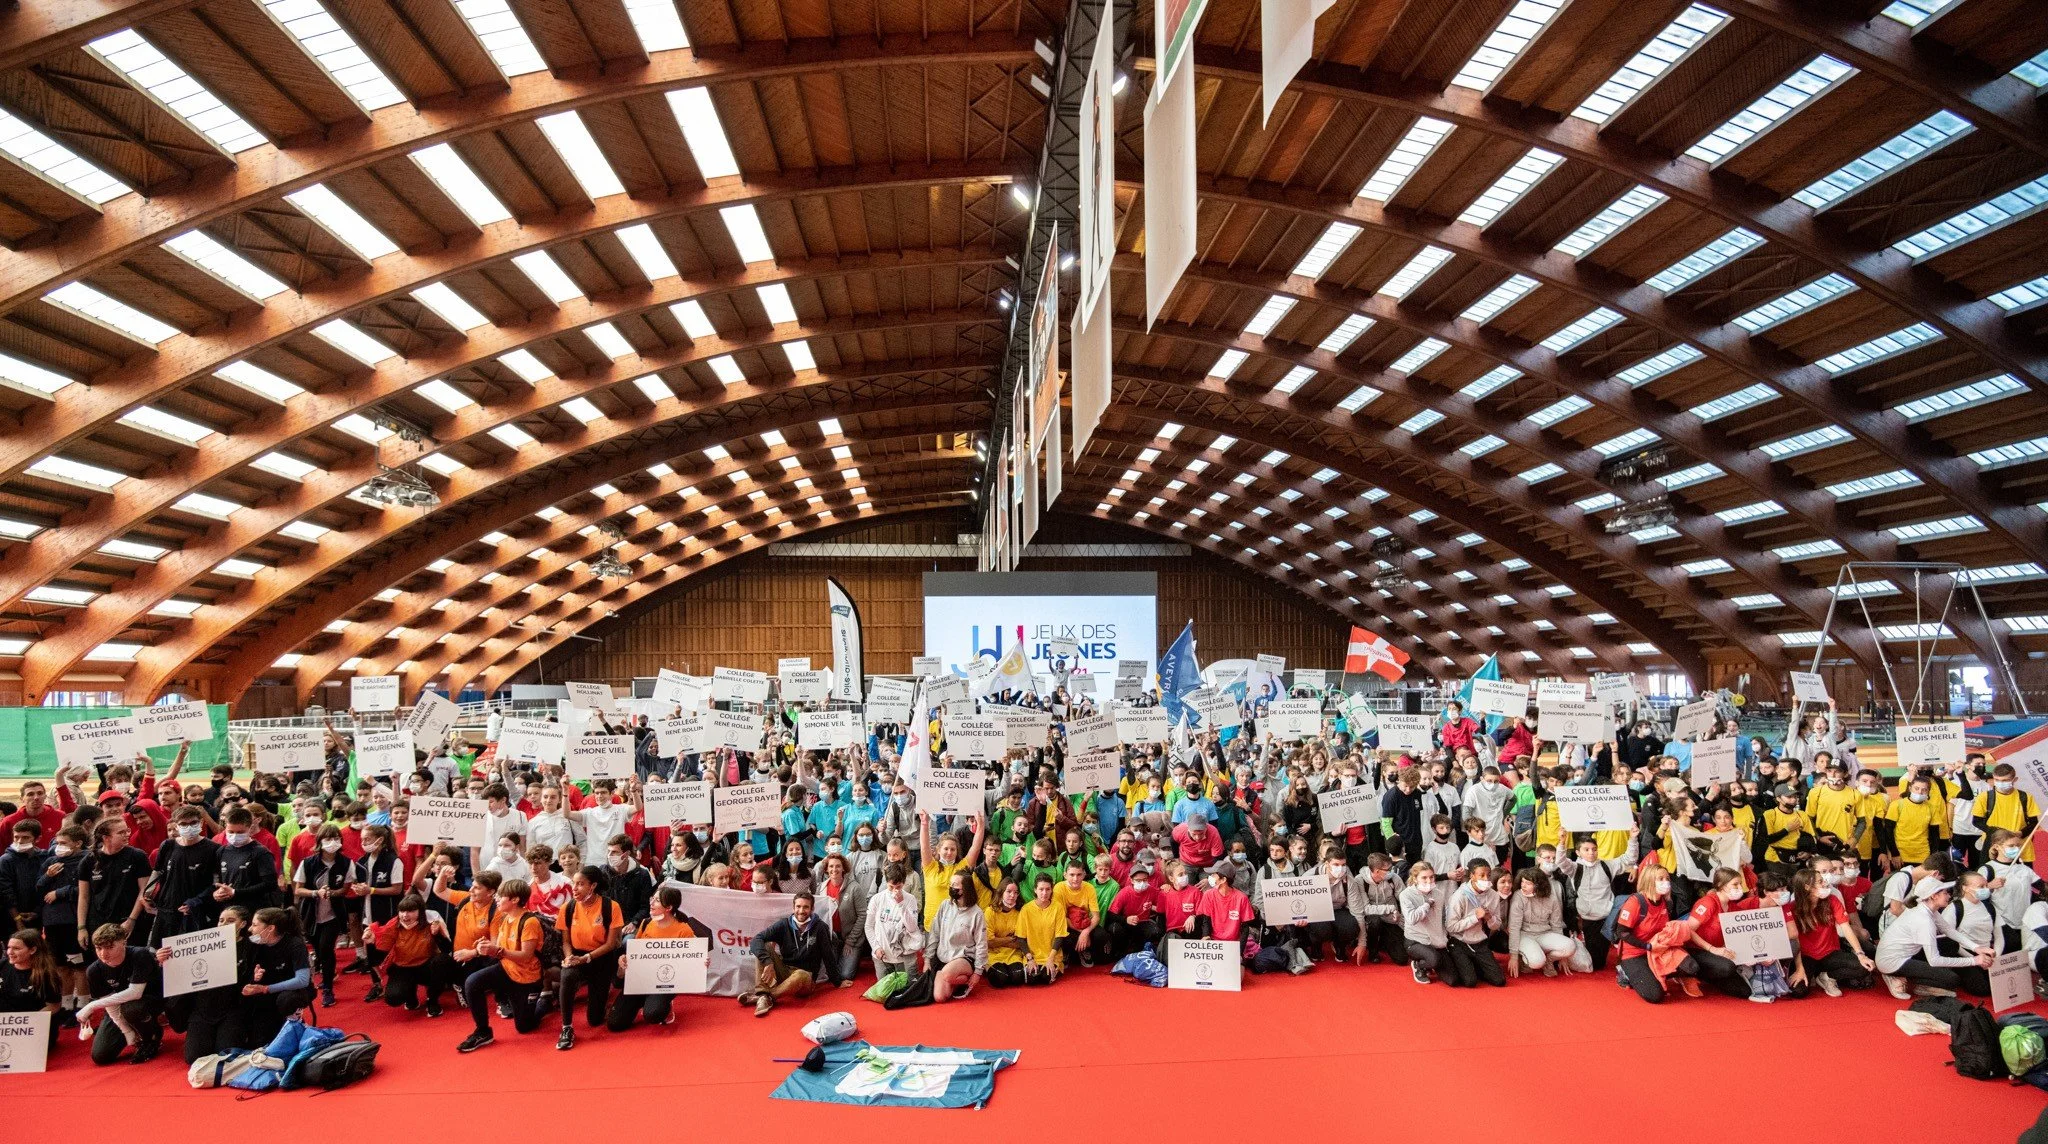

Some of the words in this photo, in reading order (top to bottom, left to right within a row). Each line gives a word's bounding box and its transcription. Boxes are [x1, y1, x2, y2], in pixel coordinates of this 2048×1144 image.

[1031, 624, 1076, 639] JEUX
[1082, 624, 1117, 639] DES
[1031, 642, 1117, 660] JENES
[726, 670, 756, 678] COLLÈGE
[1163, 653, 1177, 693] AVEYR
[714, 674, 742, 682] GABRIELLE
[928, 676, 951, 686] COLLÈGE
[928, 683, 942, 692] CTOR
[942, 680, 960, 688] DURUY
[1488, 682, 1514, 690] COLLÈGE
[1500, 690, 1526, 698] RONSARD
[150, 703, 190, 714] COLLÈGE
[1215, 702, 1234, 710] HUGO
[138, 716, 156, 725] LES
[156, 710, 204, 723] GIRAUDES
[407, 700, 428, 728] COLLÈGE
[417, 700, 438, 729] ARMORIN
[720, 712, 751, 722] COLLÈGE
[72, 720, 120, 731] COLLÈGE
[521, 721, 550, 730] COLLÈGE
[668, 718, 699, 727] COLLÈGE
[1076, 716, 1104, 726] COLLÈGE
[504, 728, 534, 736] LUCCIANA
[535, 731, 564, 739] MARIANA
[1070, 727, 1088, 736] SAINT
[1090, 722, 1113, 731] JOSEPH
[1911, 725, 1949, 733] COLLÈGE
[61, 734, 76, 742] DE
[270, 733, 308, 742] COLLÈGE
[368, 734, 400, 743] COLLÈGE
[581, 738, 619, 746] COLLÈGE
[1903, 735, 1930, 743] LOUIS
[1932, 732, 1958, 741] MERLE
[260, 742, 285, 750] SAINT
[286, 741, 320, 749] JOSEPH
[363, 742, 406, 752] MAURIENNE
[574, 747, 606, 755] SIMONE
[1077, 755, 1108, 764] COLLÈGE
[1070, 763, 1098, 772] SIMONE
[650, 786, 681, 795] COLLÈGE
[730, 786, 766, 796] COLLÈGE
[1330, 788, 1361, 799] COLLÈGE
[1571, 787, 1610, 795] COLLÈGE
[646, 794, 666, 802] SAINT
[716, 797, 752, 807] GEORGES
[754, 793, 780, 802] RAYET
[1322, 801, 1338, 810] JEAN
[1340, 794, 1373, 806] ROSTAND
[428, 800, 471, 809] COLLÈGE
[411, 808, 439, 817] SAINT
[442, 810, 486, 820] EXUPERY
[1278, 879, 1314, 888] COLLÈGE
[1265, 890, 1290, 898] HENRI
[1291, 887, 1328, 896] MONDOR
[1734, 911, 1770, 922] COLLÈGE
[1725, 924, 1758, 934] GASTON
[1760, 921, 1784, 930] FEBUS
[176, 931, 220, 946] INSTITUTION
[200, 940, 226, 953] DAME
[645, 941, 690, 949] COLLÈGE
[1184, 942, 1224, 950] COLLÈGE
[1183, 952, 1224, 961] PASTEUR
[0, 1016, 30, 1025] LÈGE
[0, 1027, 34, 1036] IENNE
